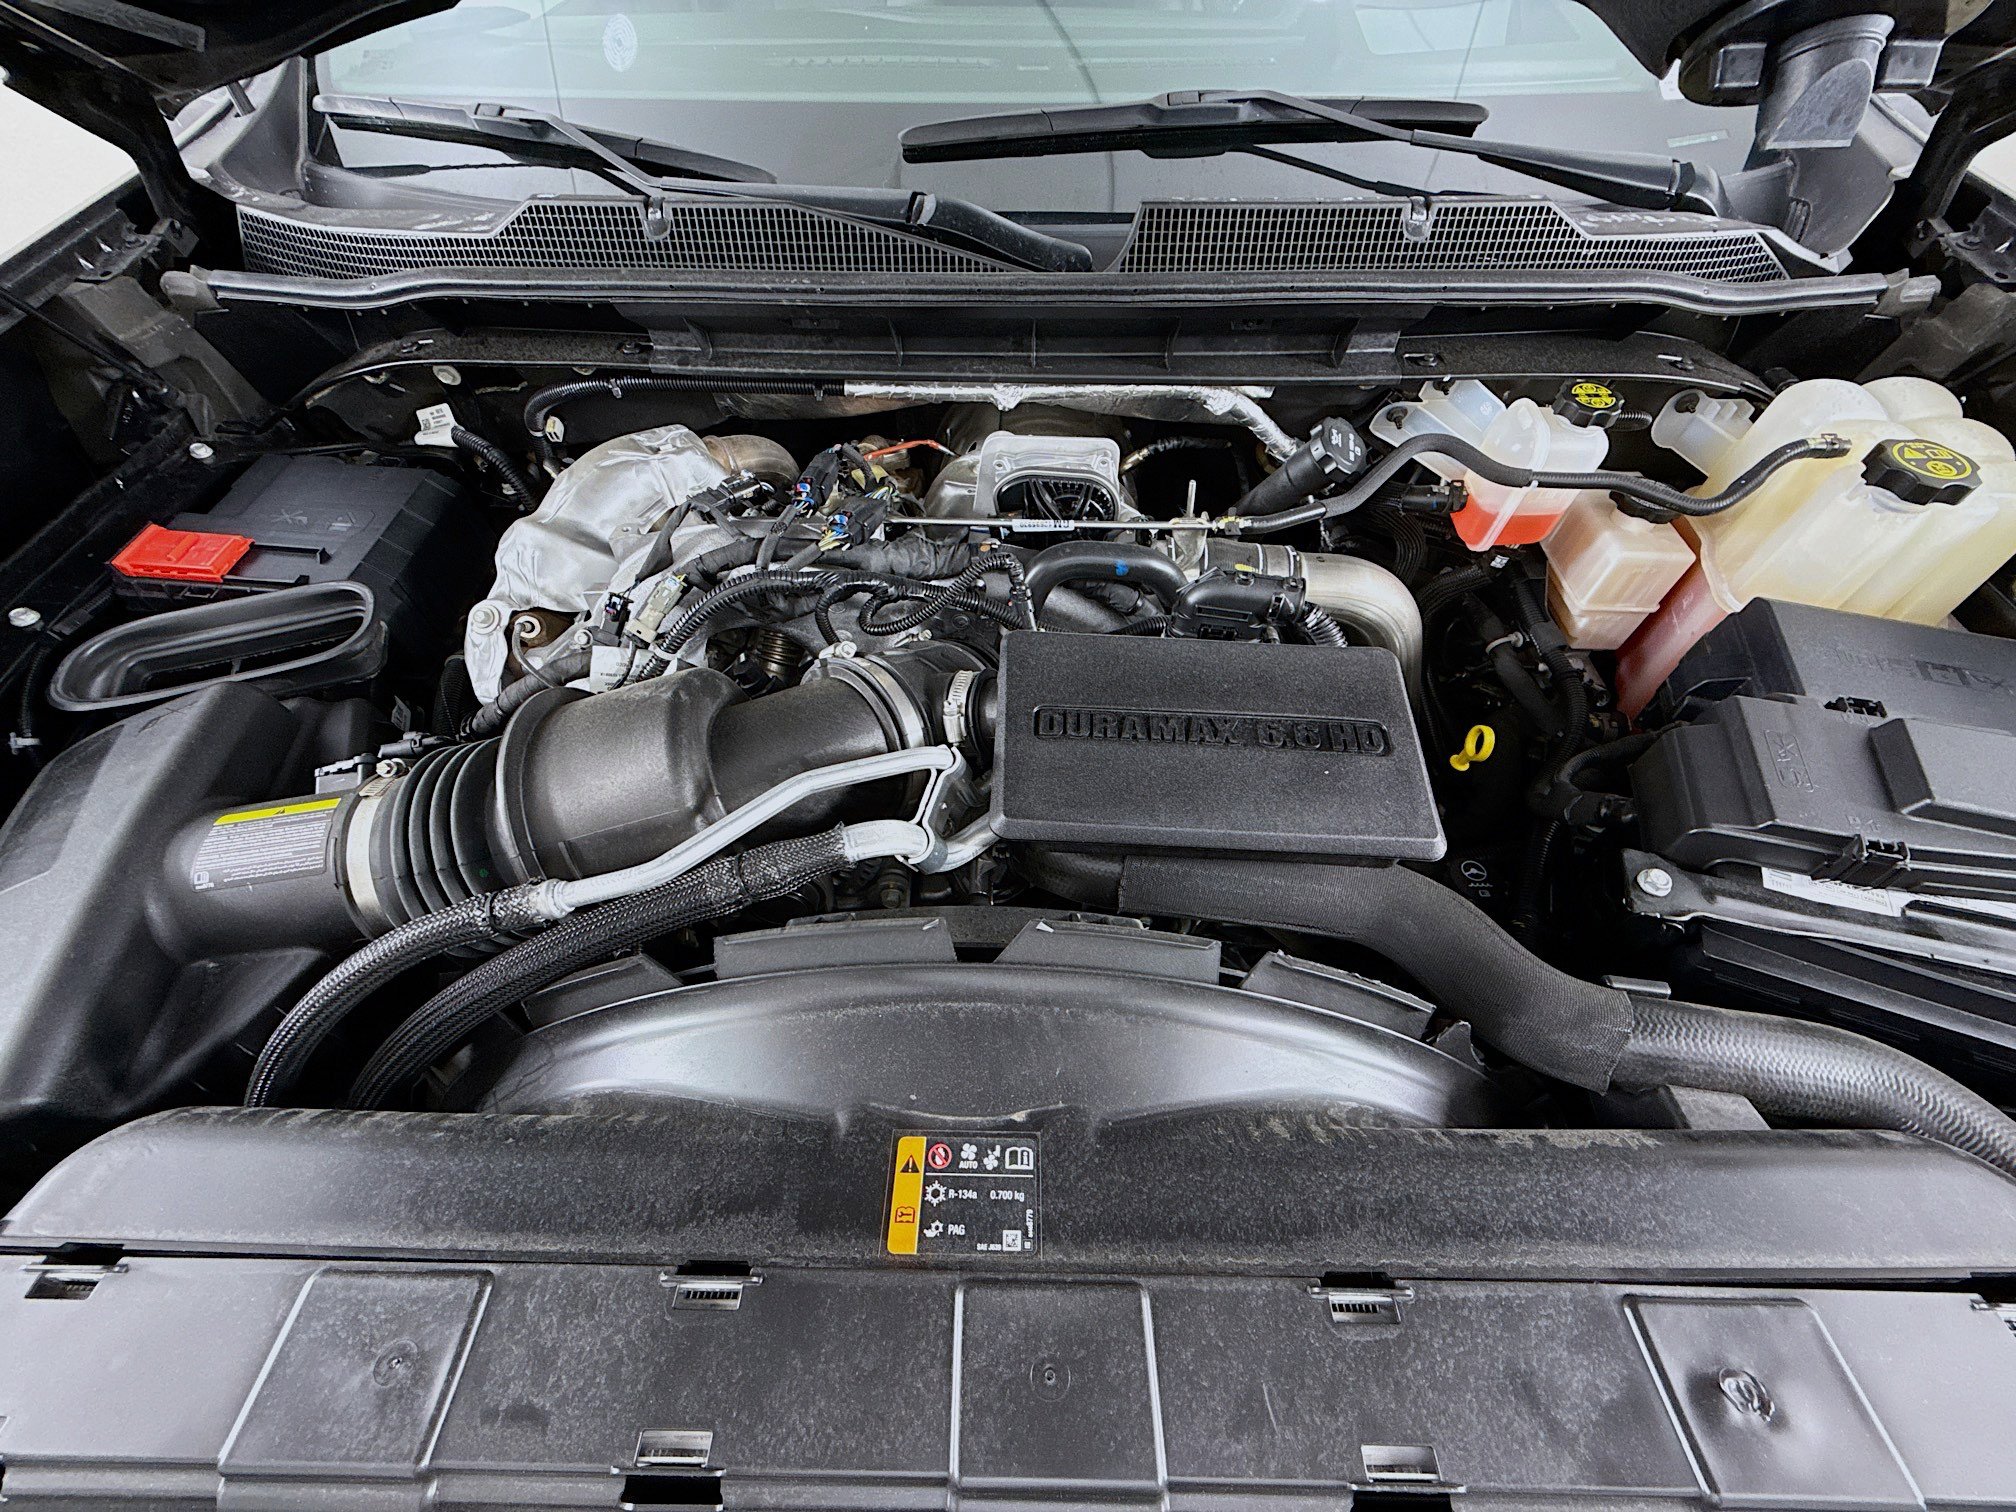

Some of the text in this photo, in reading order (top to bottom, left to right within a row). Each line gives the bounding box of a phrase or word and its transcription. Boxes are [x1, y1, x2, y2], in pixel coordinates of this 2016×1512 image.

[1038, 709, 1386, 754] DURAMAX 6.6 HD
[959, 1161, 978, 1169] AUTO
[948, 1189, 1025, 1202] R-134a 0.700 kg
[948, 1224, 965, 1235] PAG
